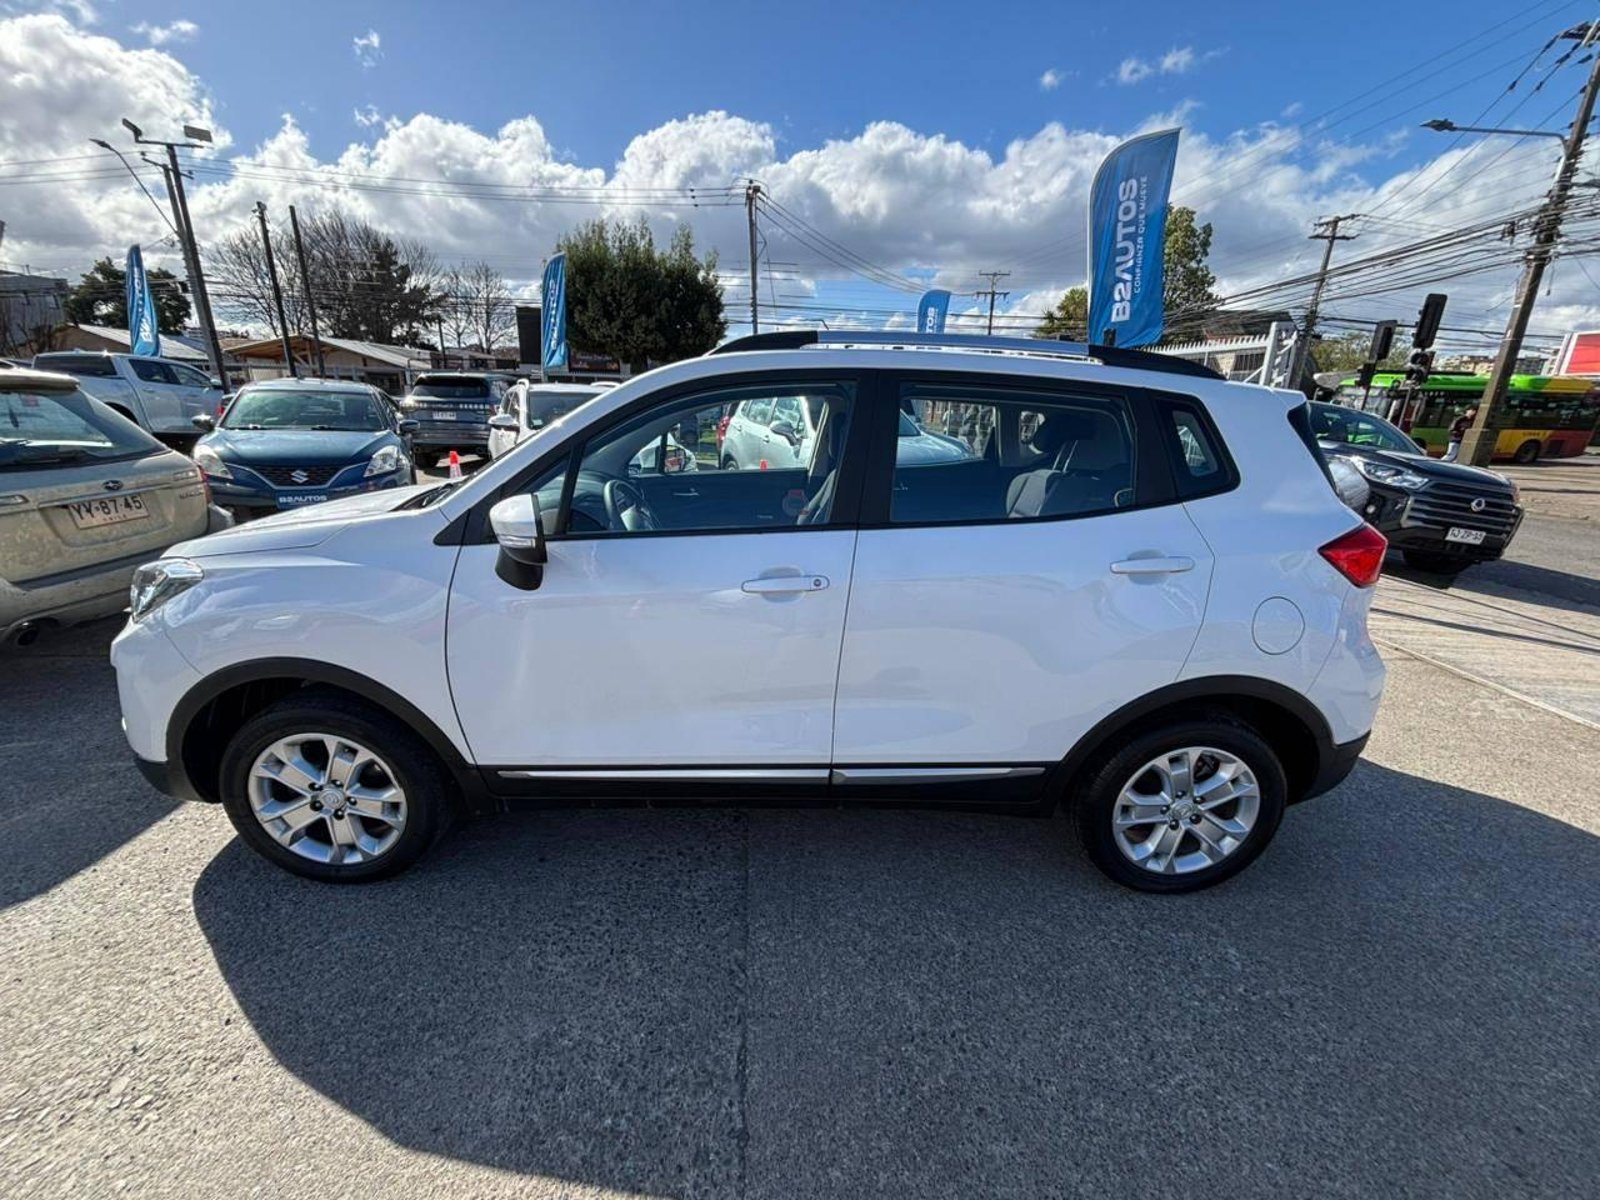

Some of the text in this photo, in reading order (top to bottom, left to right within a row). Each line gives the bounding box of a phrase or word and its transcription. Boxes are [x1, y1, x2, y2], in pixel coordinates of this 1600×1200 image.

[1137, 212, 1146, 233] QUE
[1111, 178, 1138, 322] B2AUTOS
[1134, 236, 1143, 294] CONFIANZA
[279, 495, 328, 503] B2AUTOS
